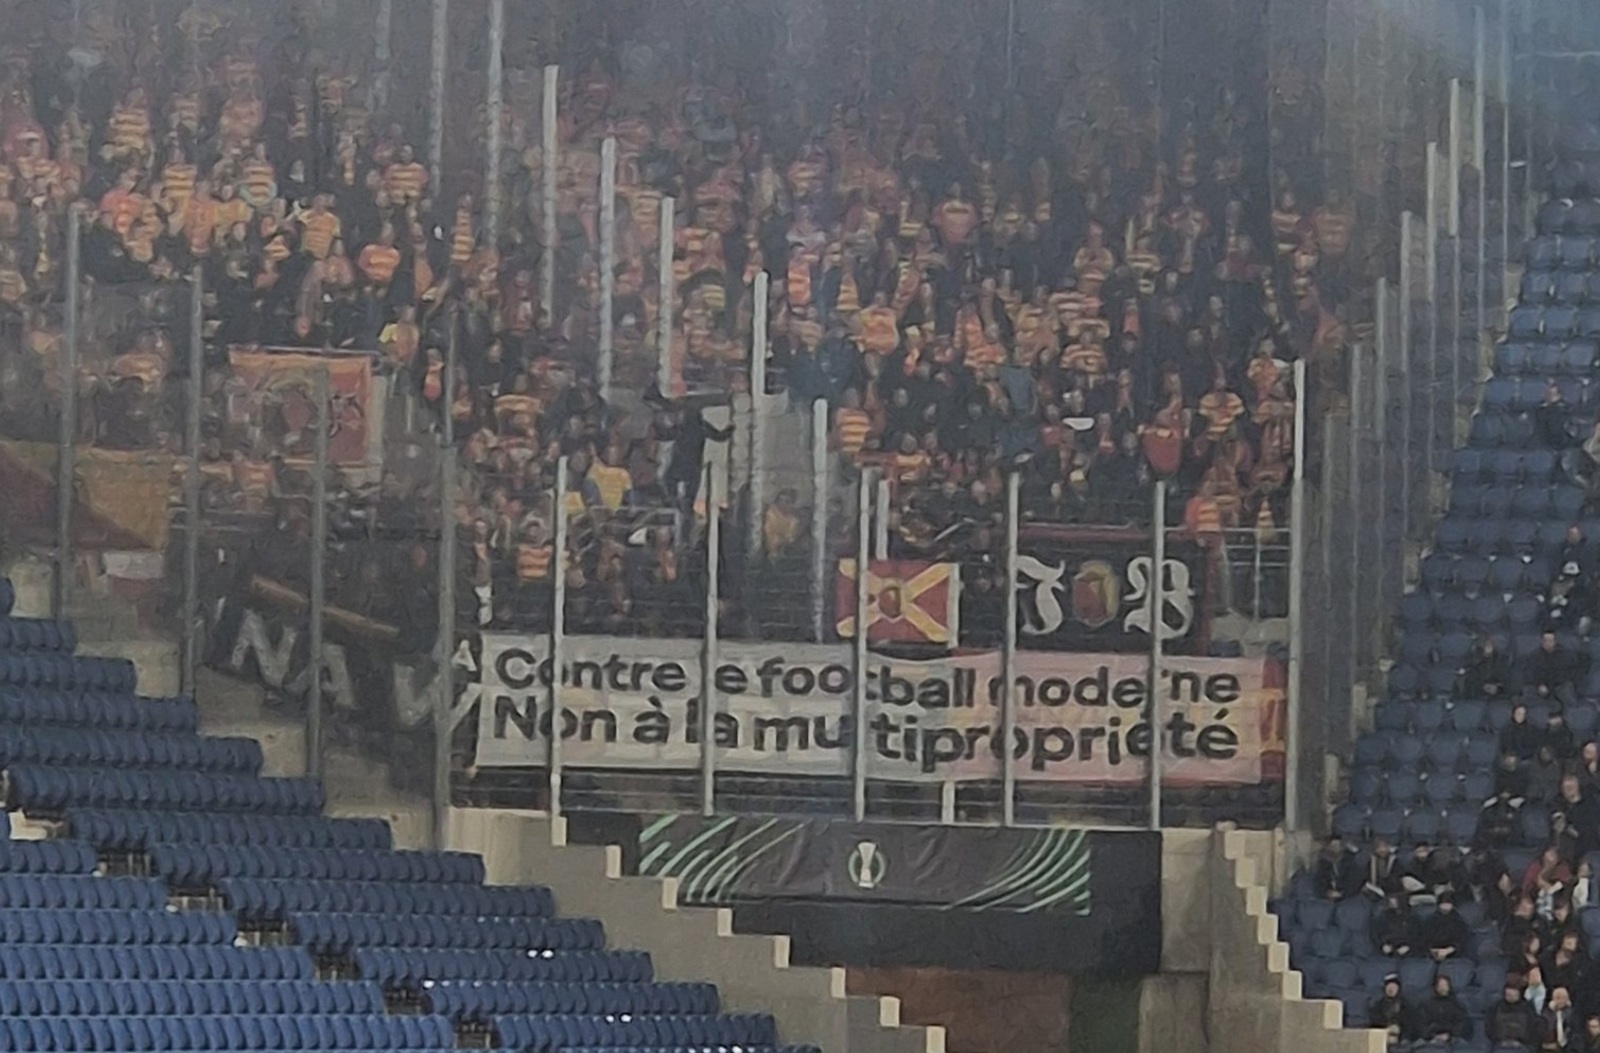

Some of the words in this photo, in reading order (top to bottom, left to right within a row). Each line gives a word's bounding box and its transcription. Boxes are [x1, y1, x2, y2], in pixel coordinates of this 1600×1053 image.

[495, 647, 687, 692] Contre
[704, 656, 748, 695] e
[988, 665, 1241, 709] modene
[494, 695, 618, 742] Non
[632, 695, 671, 745] à
[685, 696, 739, 750] la
[753, 706, 1240, 772] mutipropriété
